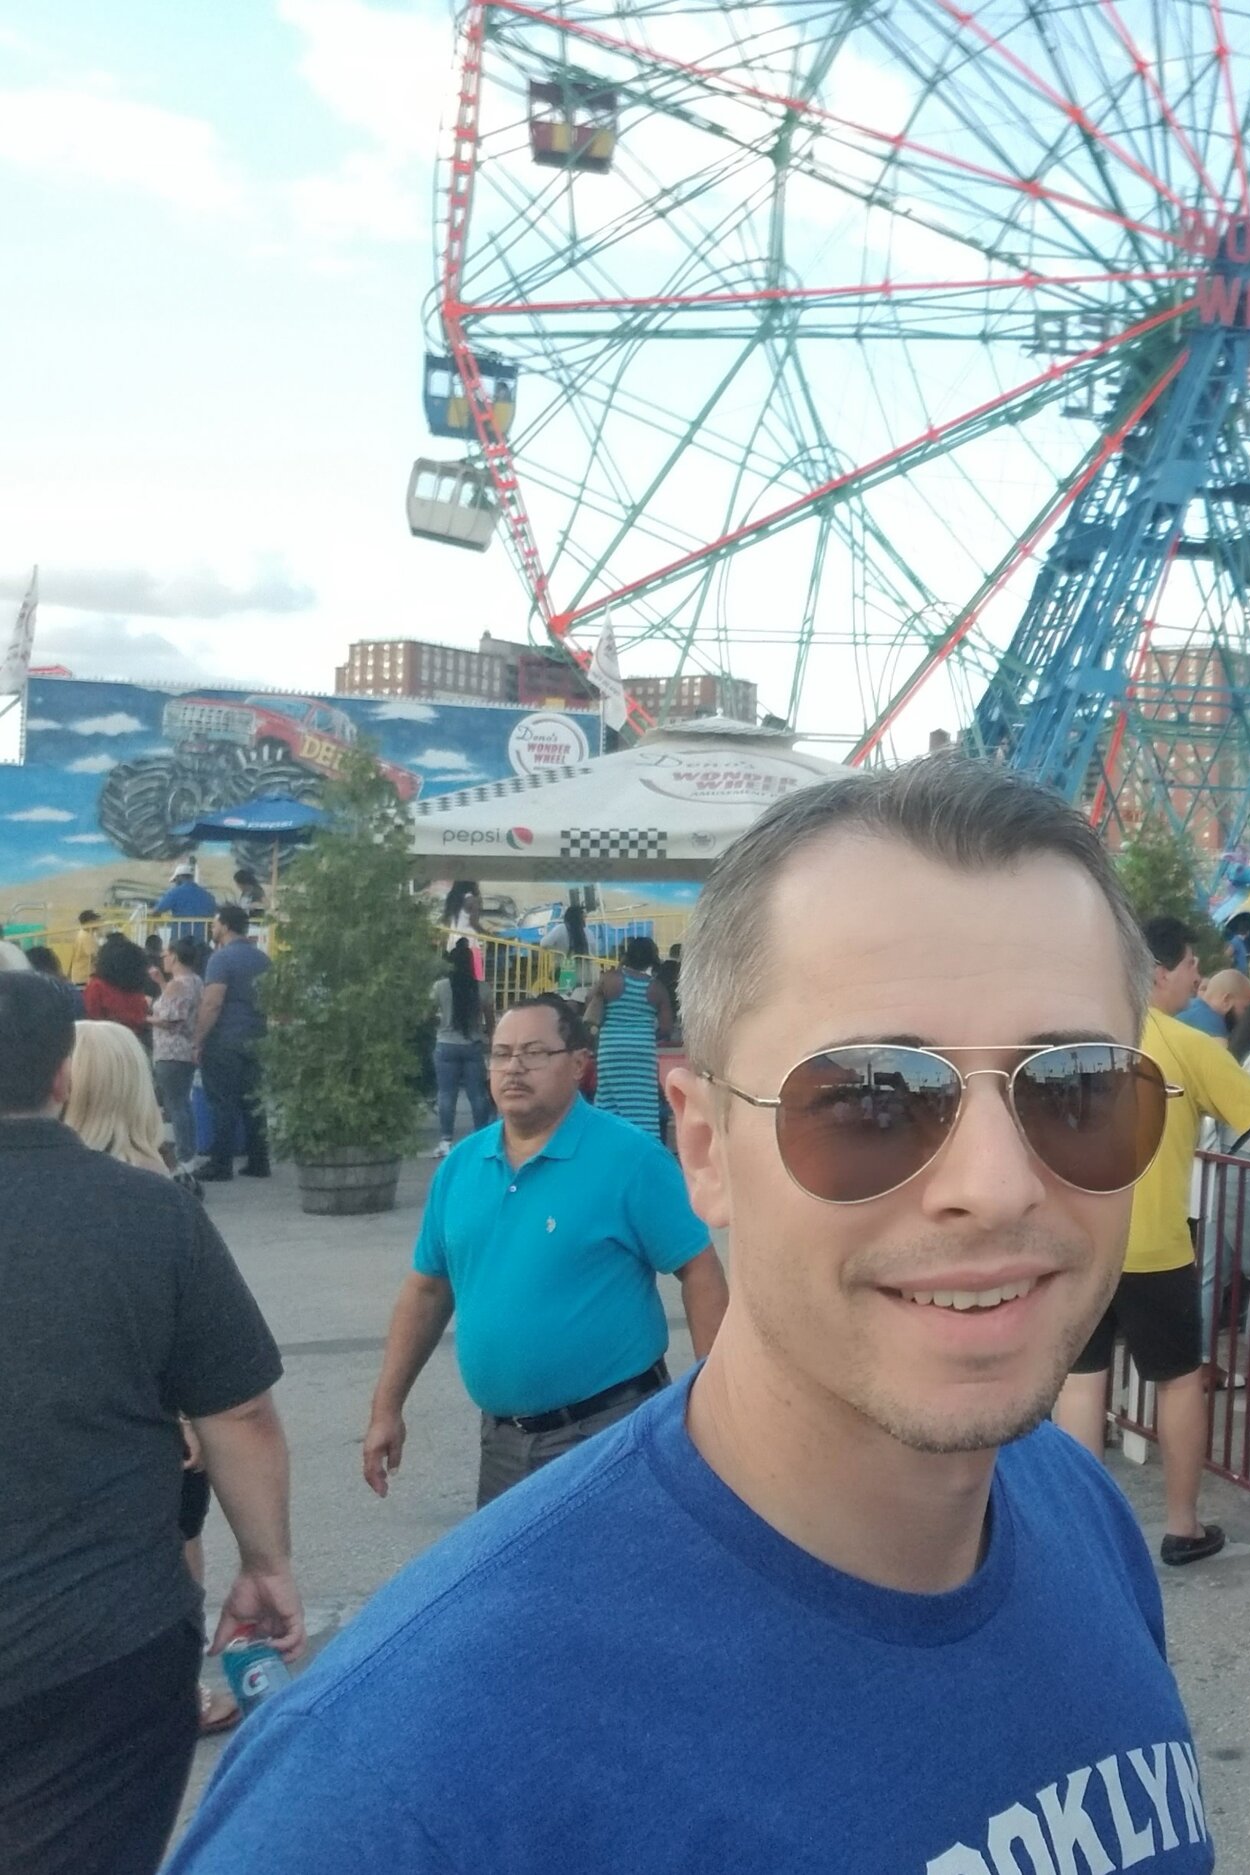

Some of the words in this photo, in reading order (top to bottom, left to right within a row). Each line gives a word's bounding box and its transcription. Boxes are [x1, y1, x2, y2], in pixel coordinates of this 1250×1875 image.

[527, 743, 570, 754] WONDER
[534, 754, 566, 764] WHEEL
[672, 771, 797, 786] WONDER
[443, 828, 500, 846] pepsi
[243, 1665, 270, 1697] G
